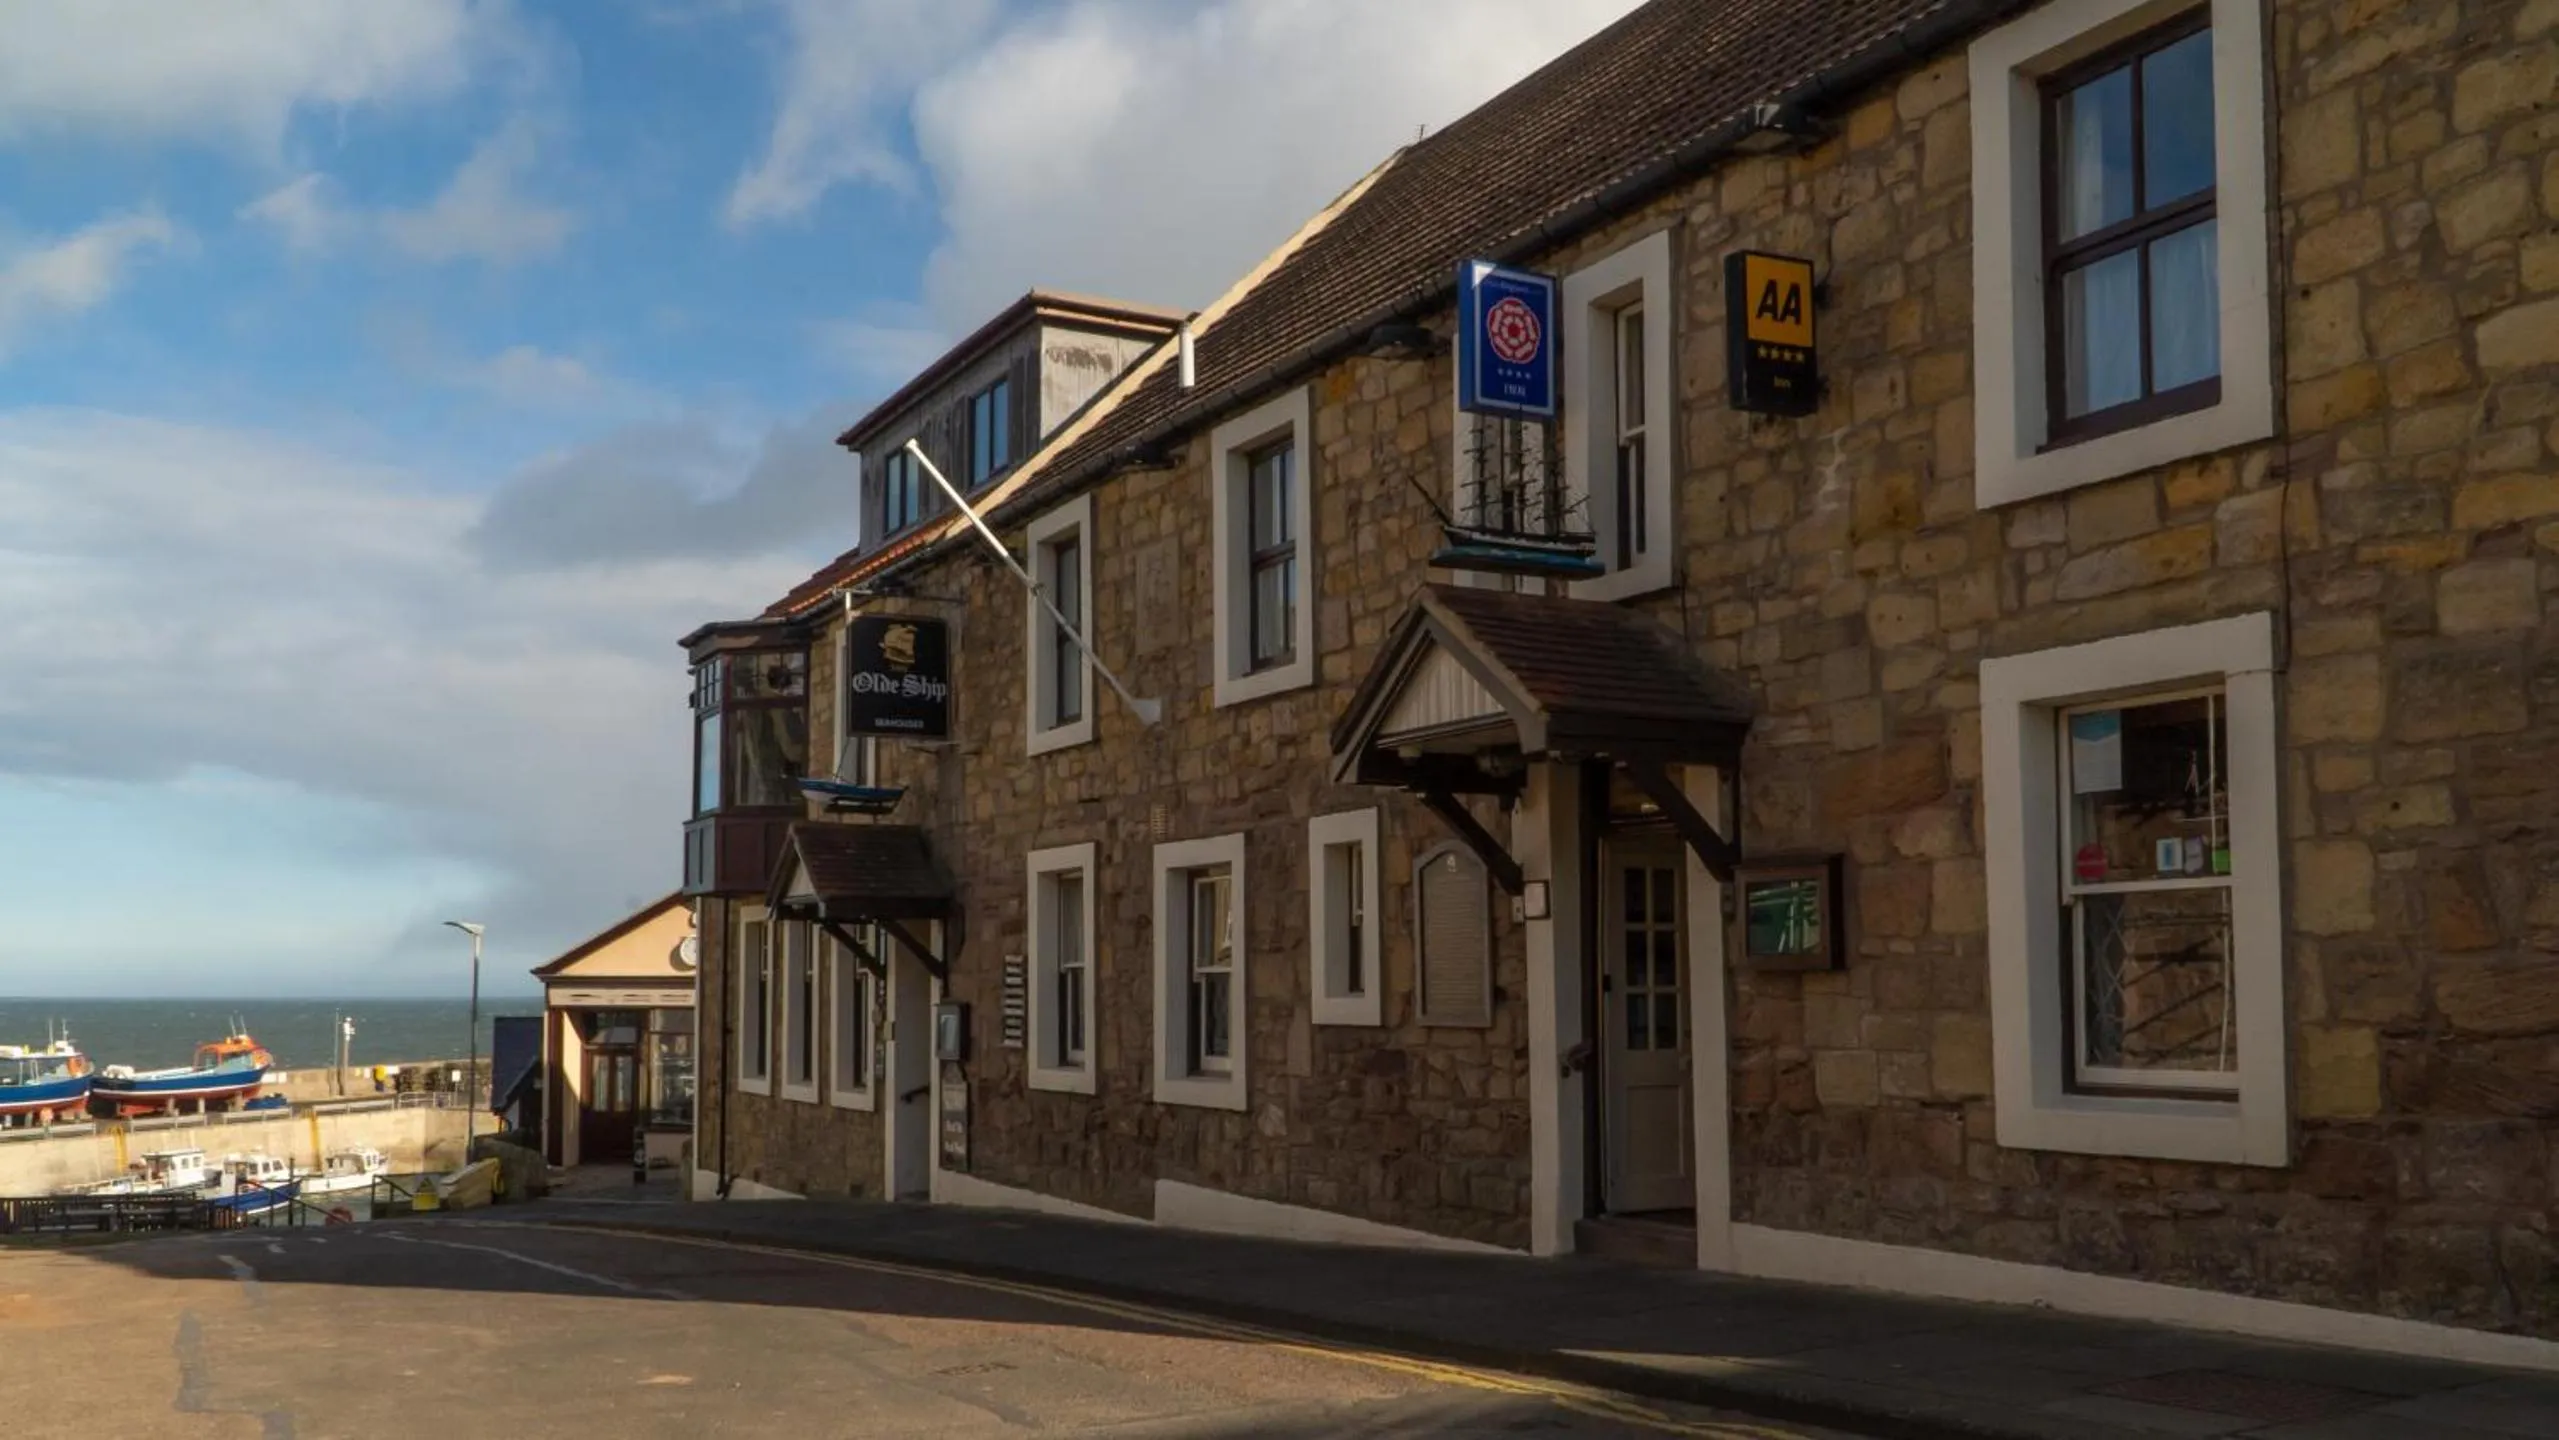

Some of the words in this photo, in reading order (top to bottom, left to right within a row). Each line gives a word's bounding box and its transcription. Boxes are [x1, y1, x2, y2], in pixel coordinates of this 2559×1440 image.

[1756, 279, 1801, 325] AA
[852, 672, 900, 693] Olde
[903, 674, 946, 703] Ship
